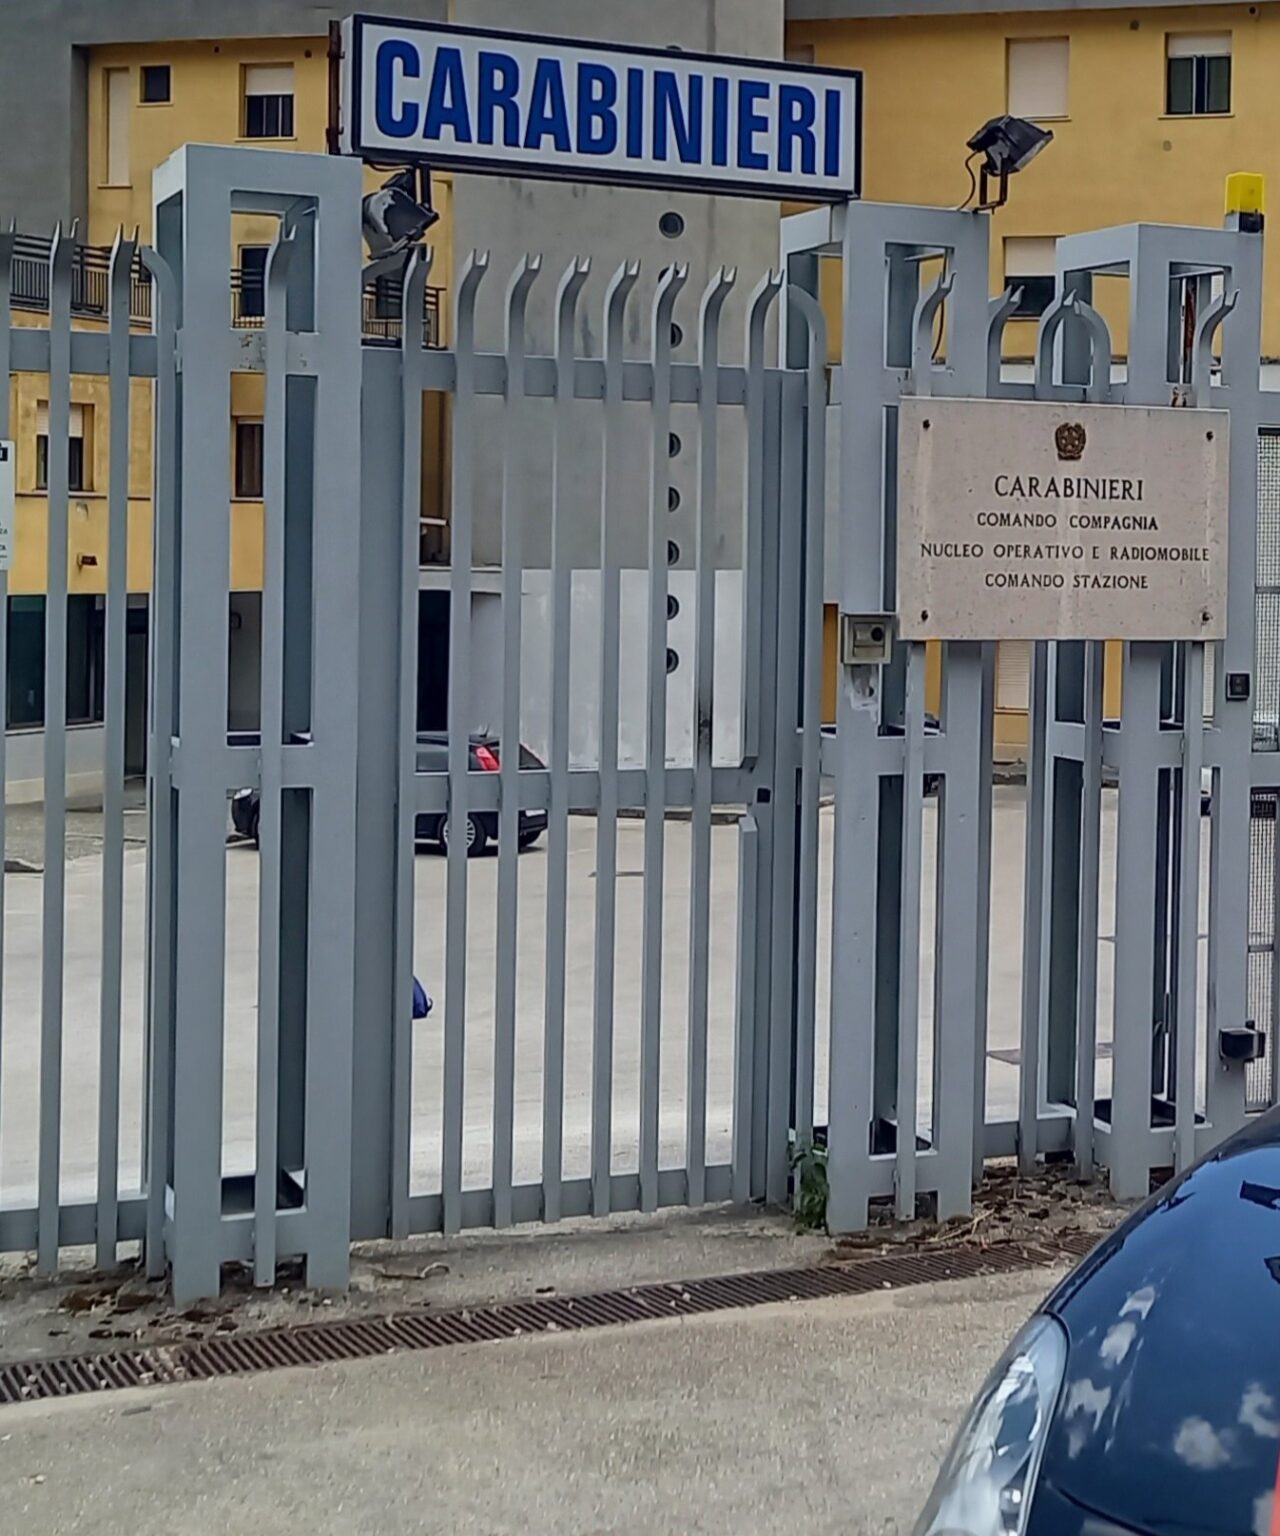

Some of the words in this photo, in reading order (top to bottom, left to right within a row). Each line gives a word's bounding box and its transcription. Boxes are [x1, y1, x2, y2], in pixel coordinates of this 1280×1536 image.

[375, 39, 842, 177] CARABINIERI
[994, 475, 1143, 501] CARABINIERI
[977, 512, 1057, 528] COMANDO
[1069, 514, 1159, 531] COMPAGNIA
[921, 543, 984, 558] NUCLEO
[993, 544, 1084, 559] OPERATIVO
[1092, 546, 1100, 559] E
[1110, 546, 1210, 561] RADIOMOBILE
[985, 573, 1065, 588] COMANDO
[1072, 574, 1149, 589] STAZIONE
